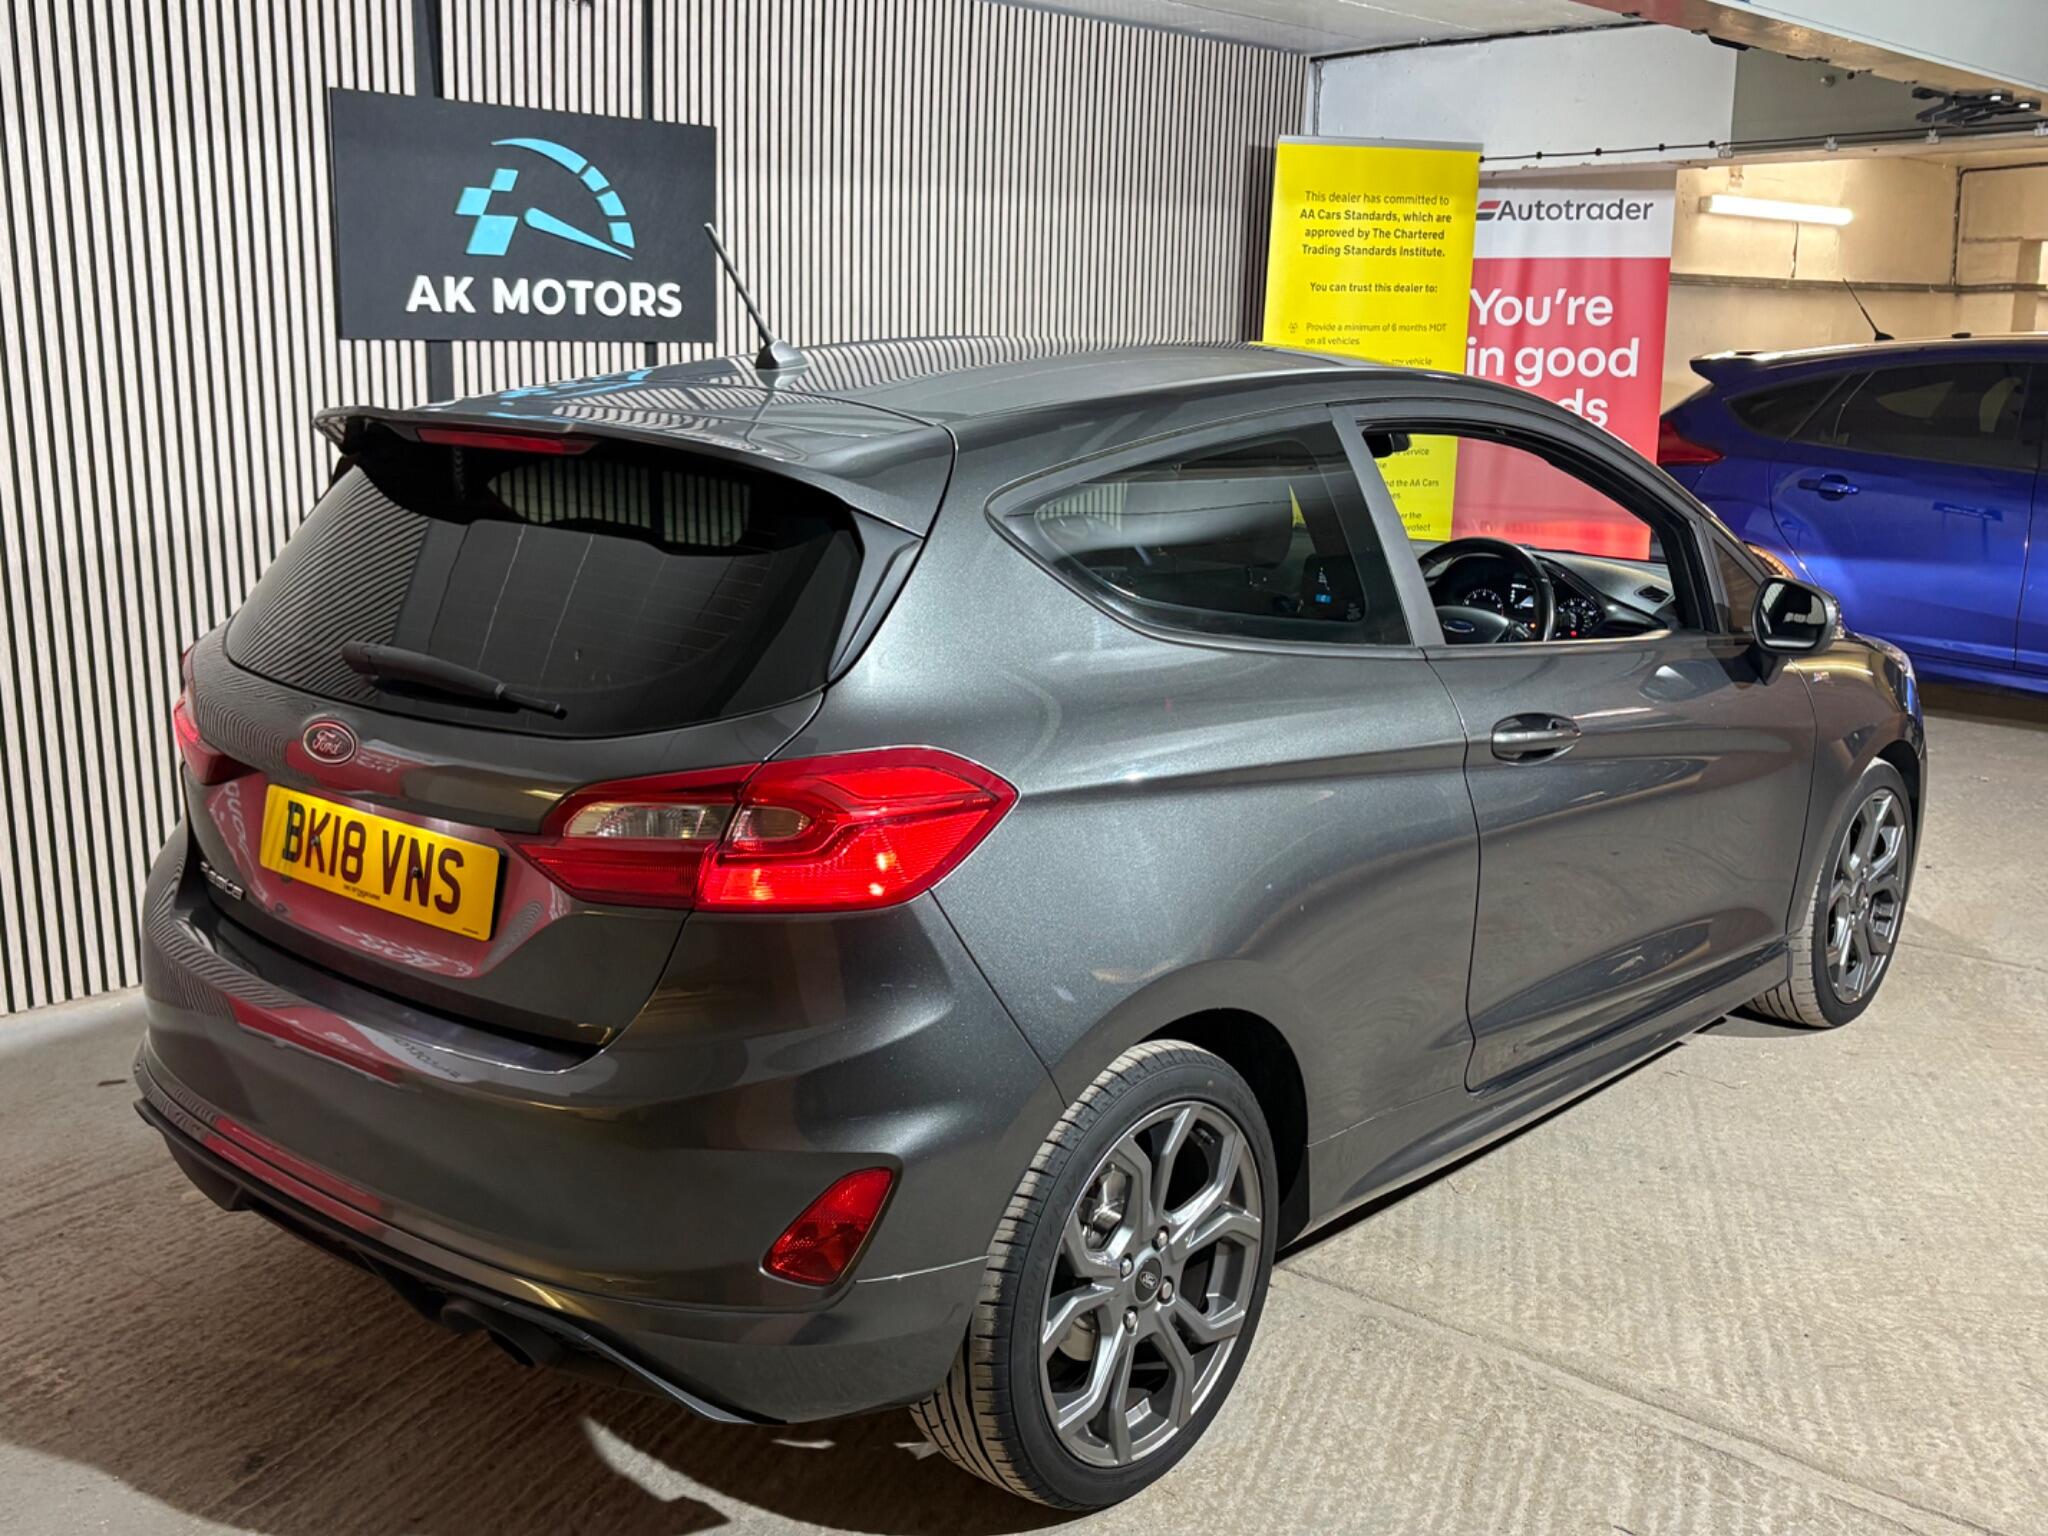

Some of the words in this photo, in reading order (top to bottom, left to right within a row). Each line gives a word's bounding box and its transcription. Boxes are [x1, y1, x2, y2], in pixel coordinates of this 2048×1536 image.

[1305, 190, 1326, 202] This
[1329, 191, 1361, 203] dealer
[1363, 192, 1381, 204] has
[1384, 194, 1437, 205] committed
[1440, 195, 1450, 206] to
[1300, 208, 1315, 219] AA
[1318, 209, 1341, 220] Cars
[1344, 210, 1401, 222] Standards,
[1403, 211, 1433, 222] which
[1435, 213, 1452, 223] are
[1498, 198, 1654, 221] Autotrader
[1305, 226, 1354, 239] approved
[1357, 227, 1370, 240] by
[1373, 227, 1391, 239] The
[1393, 228, 1445, 240] Chartered
[1302, 244, 1341, 257] Trading
[1343, 244, 1397, 256] Standards
[1399, 245, 1446, 257] Institute.
[1310, 282, 1327, 292] You
[1329, 284, 1346, 292] can
[1349, 283, 1372, 293] trust
[1375, 282, 1392, 292] this
[1393, 283, 1423, 293] dealer
[1425, 283, 1438, 293] to:
[406, 275, 476, 313] AK
[493, 277, 682, 318] MOTORS
[1470, 287, 1614, 327] You're
[1306, 322, 1336, 332] Provide
[1344, 322, 1381, 332] minimum
[1382, 322, 1390, 332] of
[1391, 322, 1398, 332] 6
[1399, 322, 1428, 332] months
[1429, 322, 1447, 332] MOT
[1305, 337, 1315, 345] on
[1317, 336, 1326, 345] all
[1327, 336, 1360, 345] vehicles
[1406, 356, 1433, 366] vehicle
[1466, 336, 1505, 377] in
[1514, 337, 1640, 387] good
[1396, 479, 1409, 487] the
[1410, 479, 1421, 487] AA
[1422, 479, 1439, 487] Cars
[312, 729, 342, 755] Ford
[282, 799, 367, 884] BK18
[382, 829, 464, 915] VNS
